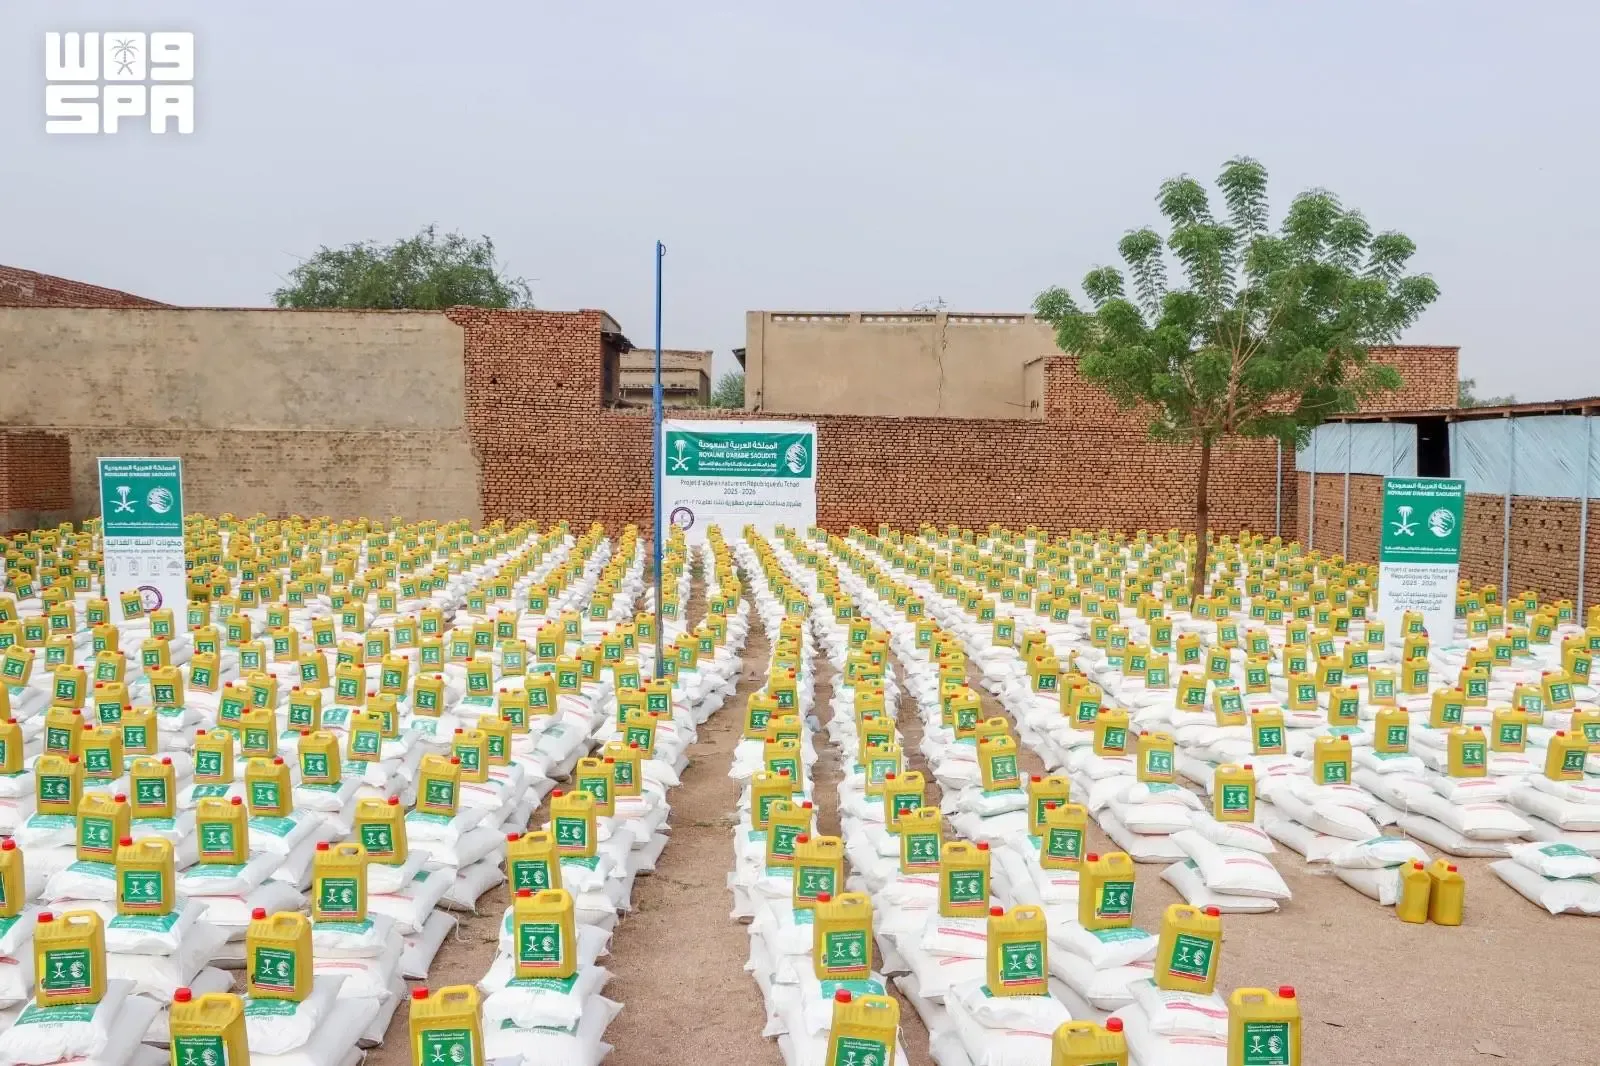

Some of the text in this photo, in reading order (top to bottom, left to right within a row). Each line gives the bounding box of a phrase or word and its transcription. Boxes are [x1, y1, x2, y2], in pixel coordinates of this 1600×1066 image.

[698, 439, 778, 450] المملكة العربية السعودية
[156, 538, 182, 548] مكونات
